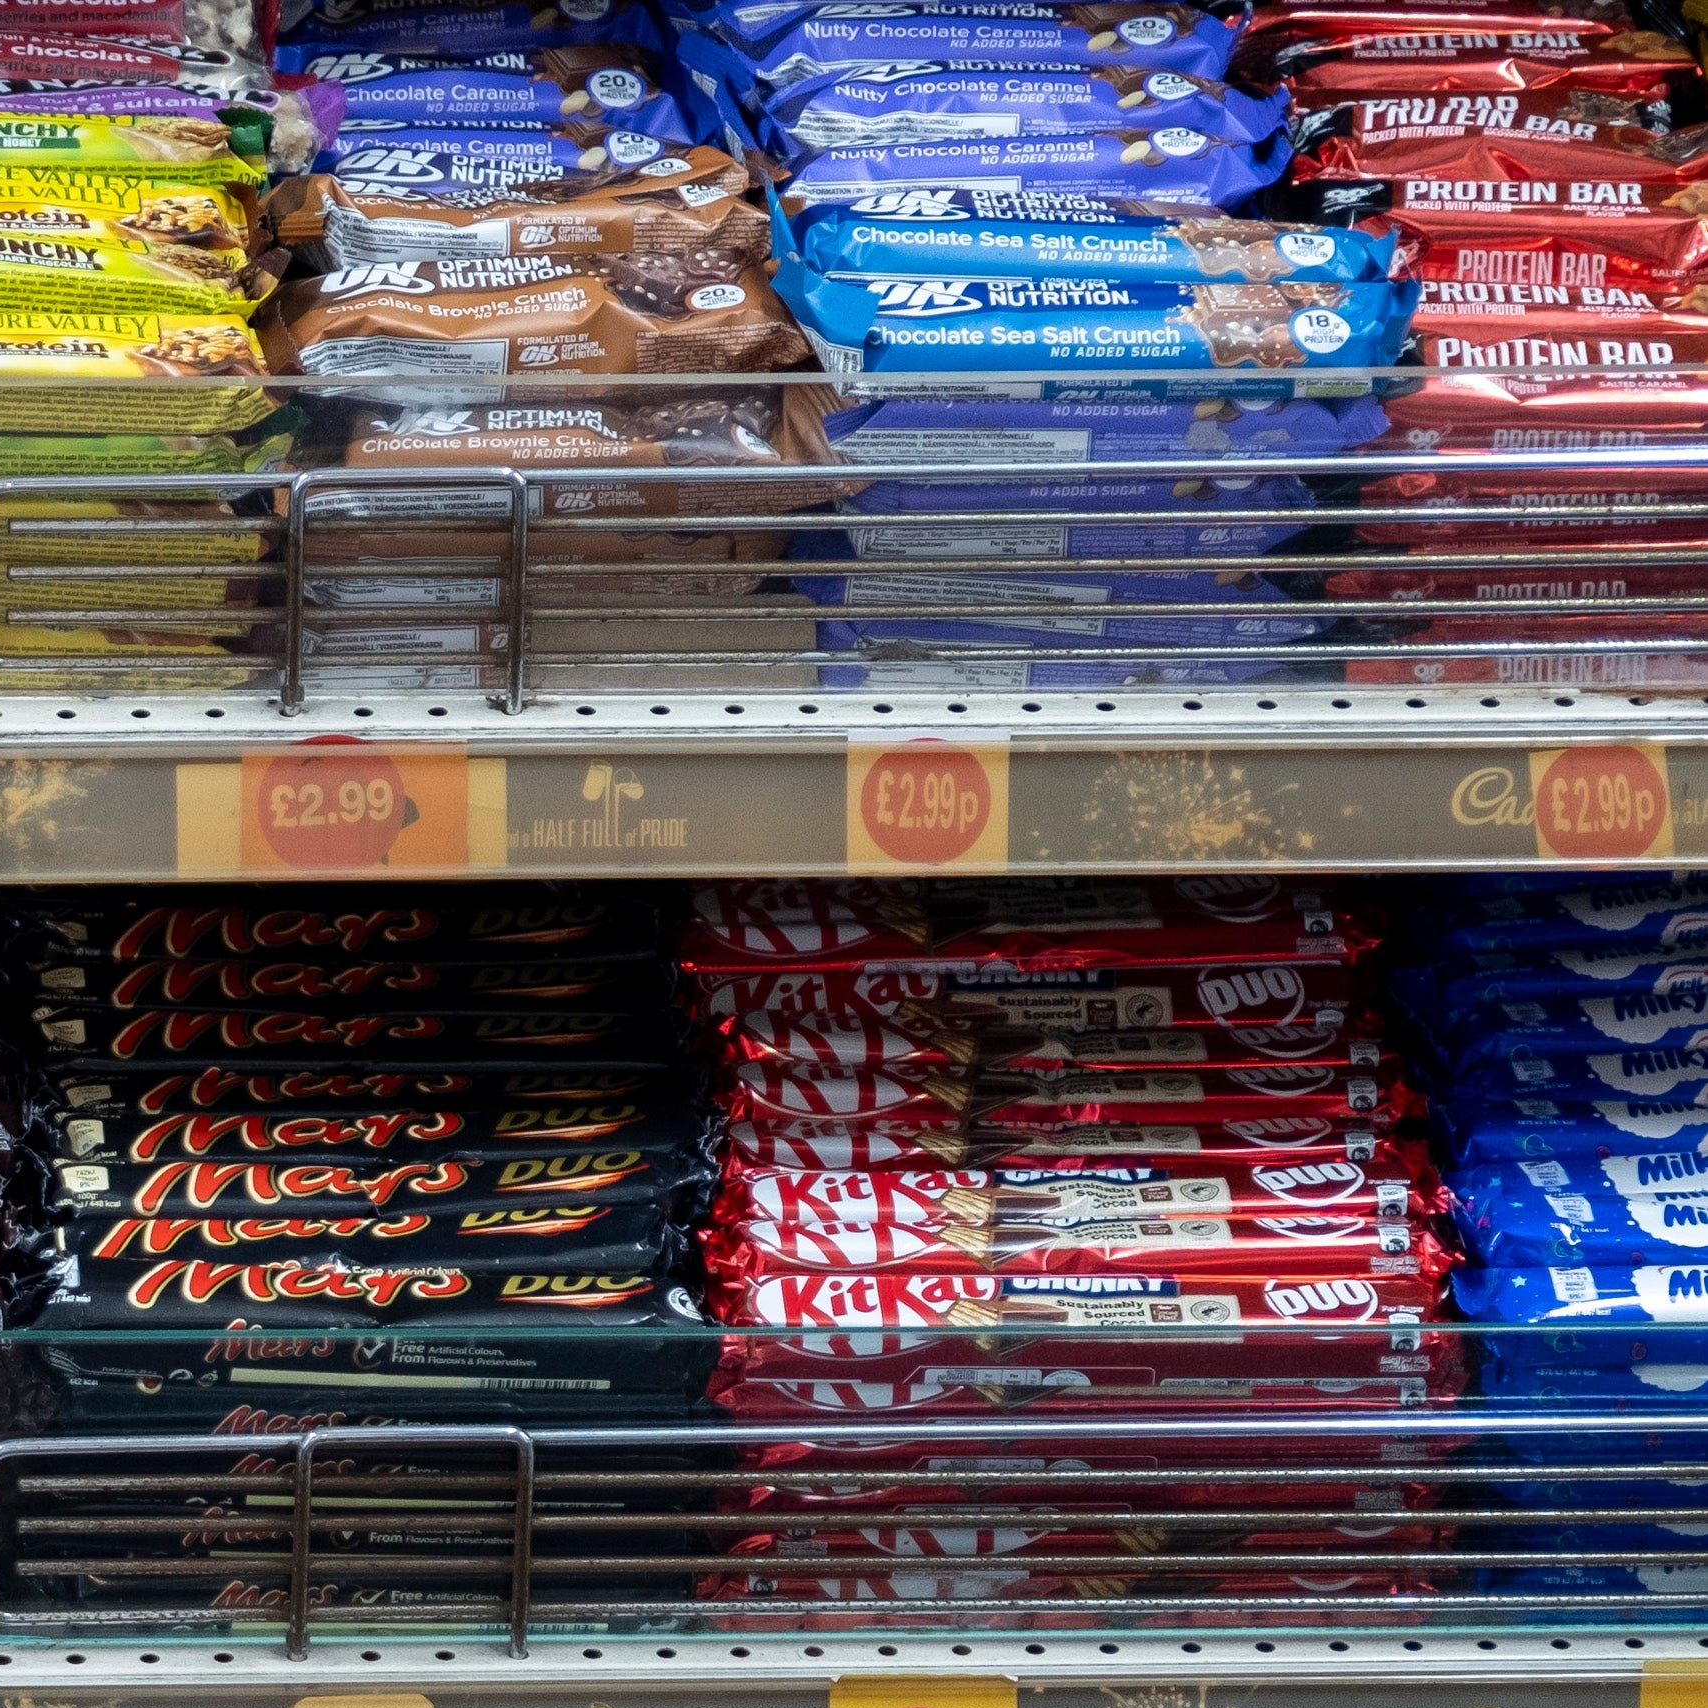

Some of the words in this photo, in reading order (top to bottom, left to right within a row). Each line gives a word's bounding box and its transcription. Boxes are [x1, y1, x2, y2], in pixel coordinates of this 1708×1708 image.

[346, 86, 447, 103] Chocolate
[453, 85, 536, 102] Caramel
[1406, 180, 1560, 205] PROTEIN
[1570, 181, 1643, 205] BAR
[870, 326, 982, 346] Chocolate
[989, 326, 1029, 345] Sea
[1035, 325, 1080, 344] Salt
[1085, 323, 1181, 345] Crunch
[271, 777, 395, 827] £2.99
[877, 772, 979, 831] £2.99p
[1551, 772, 1655, 834] £2.99p
[131, 1160, 483, 1215] Mars
[499, 1151, 641, 1185] DUO
